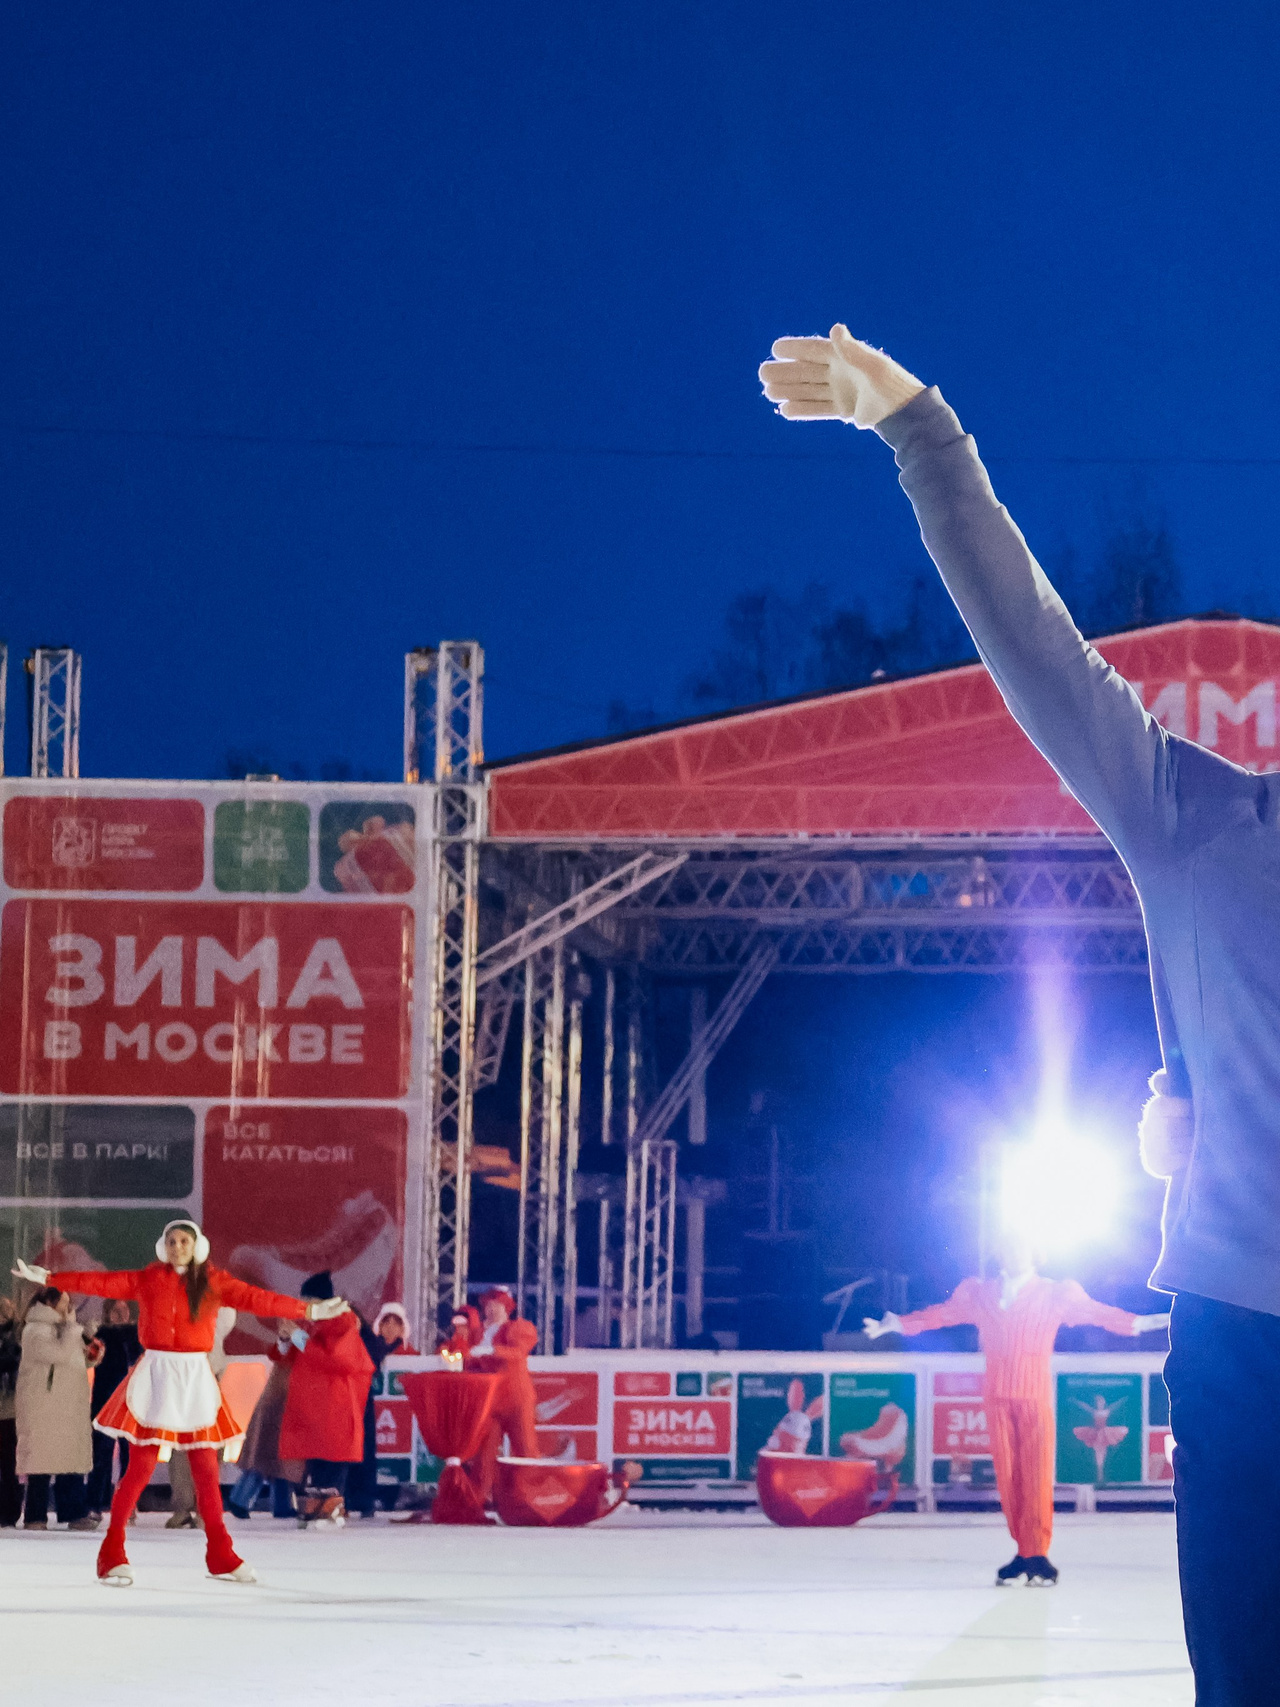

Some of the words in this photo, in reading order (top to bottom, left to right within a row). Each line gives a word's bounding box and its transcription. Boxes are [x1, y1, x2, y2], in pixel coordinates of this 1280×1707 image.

[45, 933, 365, 1009] ЗИМА
[43, 1020, 82, 1060] В
[104, 1022, 364, 1064] МОСКВЕ
[222, 1121, 271, 1140] ВСЕ
[16, 1142, 65, 1160] ВСЕ
[72, 1142, 88, 1160] В
[95, 1142, 169, 1162] ПАРК!
[222, 1144, 355, 1163] КАТАТЬСЯ!
[628, 1408, 717, 1432] ЗИМА
[947, 1409, 988, 1431] ЗИ
